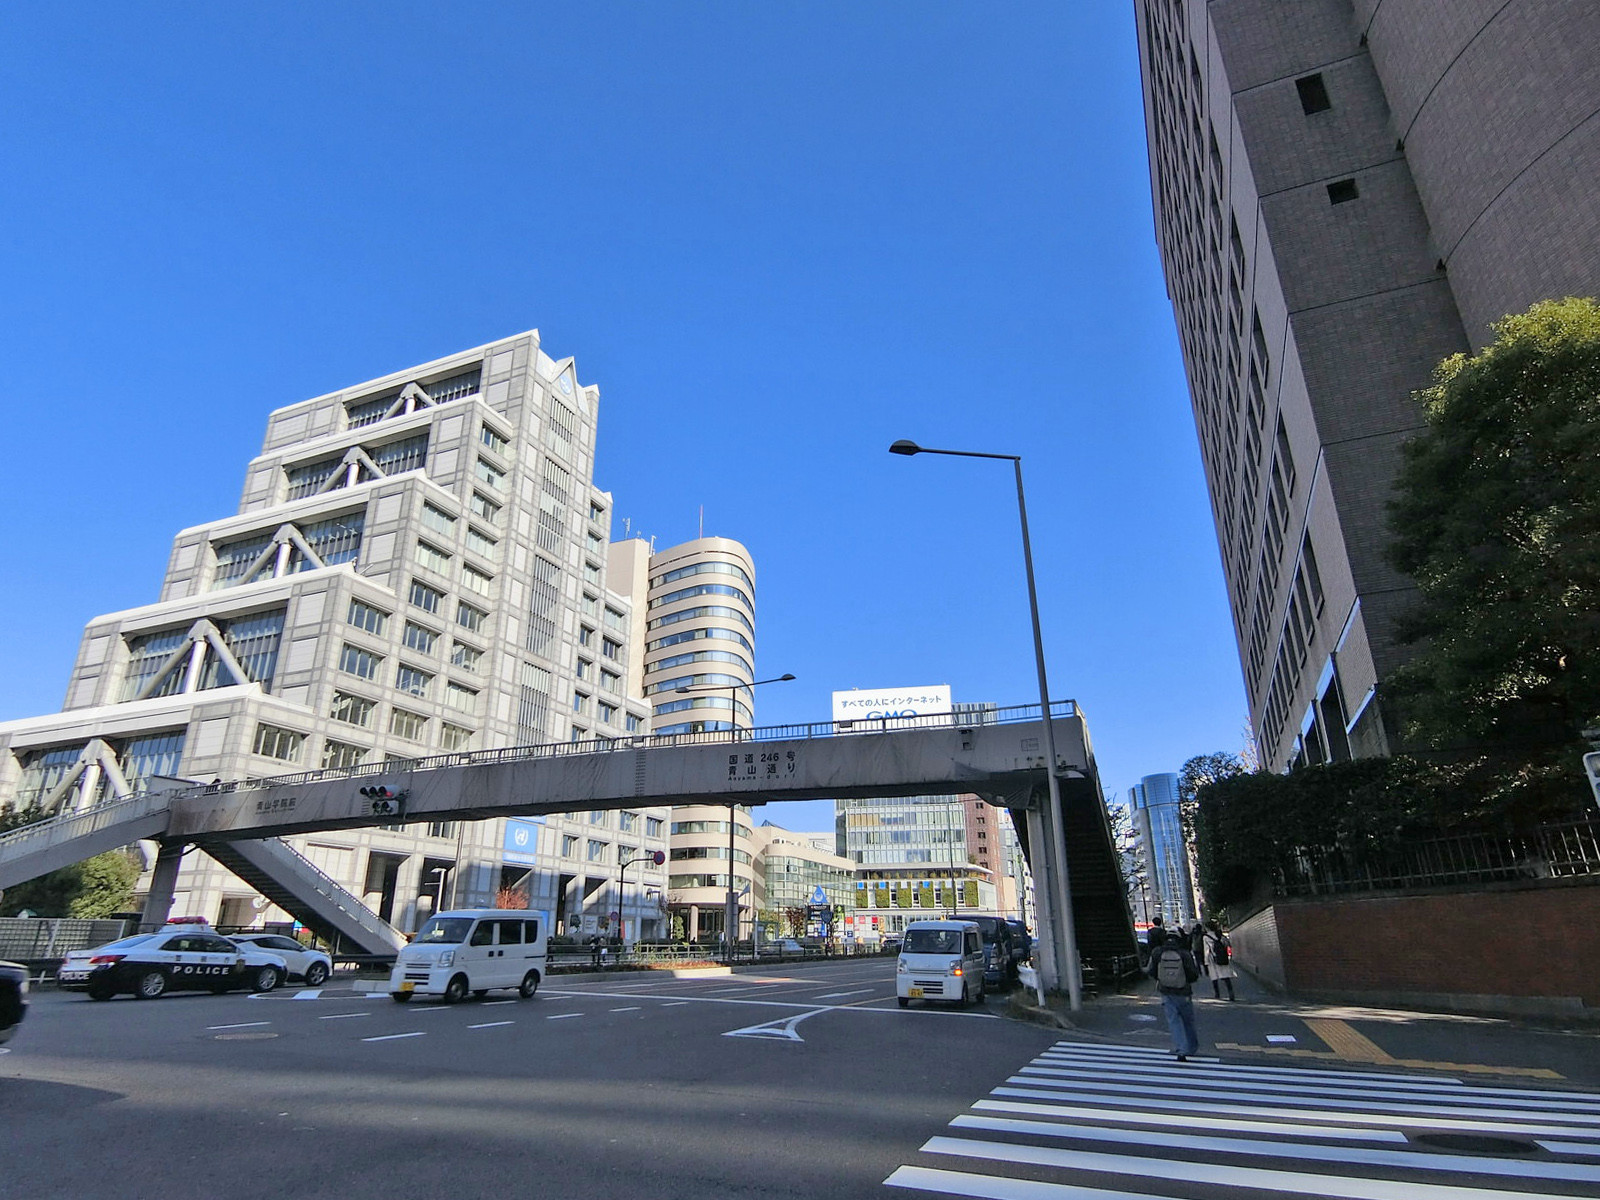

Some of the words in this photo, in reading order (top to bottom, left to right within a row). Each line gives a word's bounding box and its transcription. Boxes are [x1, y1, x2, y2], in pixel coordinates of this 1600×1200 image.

[841, 695, 942, 708] すべての人にインターネット
[866, 709, 918, 721] GMO
[728, 751, 796, 765] 国道246号
[728, 762, 795, 776] 青山通り
[60, 971, 91, 981] POLICE
[173, 965, 230, 975] POLICE
